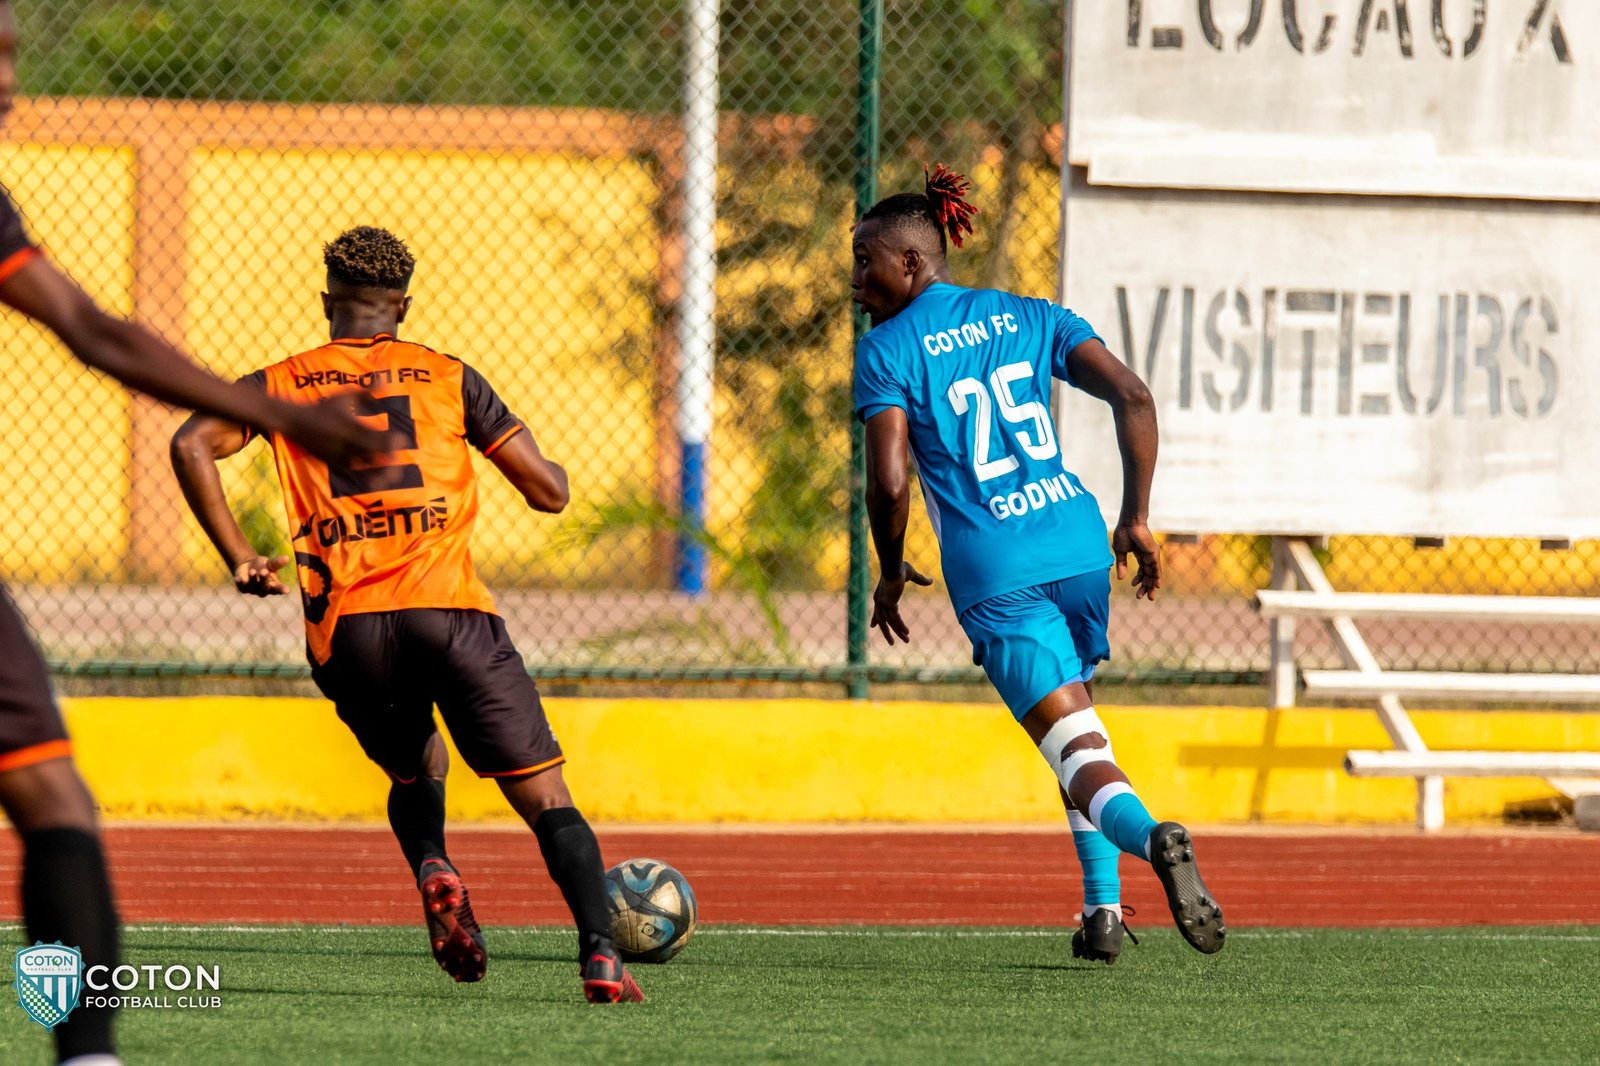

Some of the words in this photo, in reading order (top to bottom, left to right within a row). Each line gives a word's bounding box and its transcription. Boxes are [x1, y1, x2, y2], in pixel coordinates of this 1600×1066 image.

[923, 320, 990, 356] COTON
[990, 312, 1018, 336] FC
[1115, 285, 1560, 418] VISITEURS
[295, 369, 392, 389] DRAGON
[398, 368, 431, 383] FC
[947, 360, 1058, 483] 25
[989, 473, 1084, 520] GODWI
